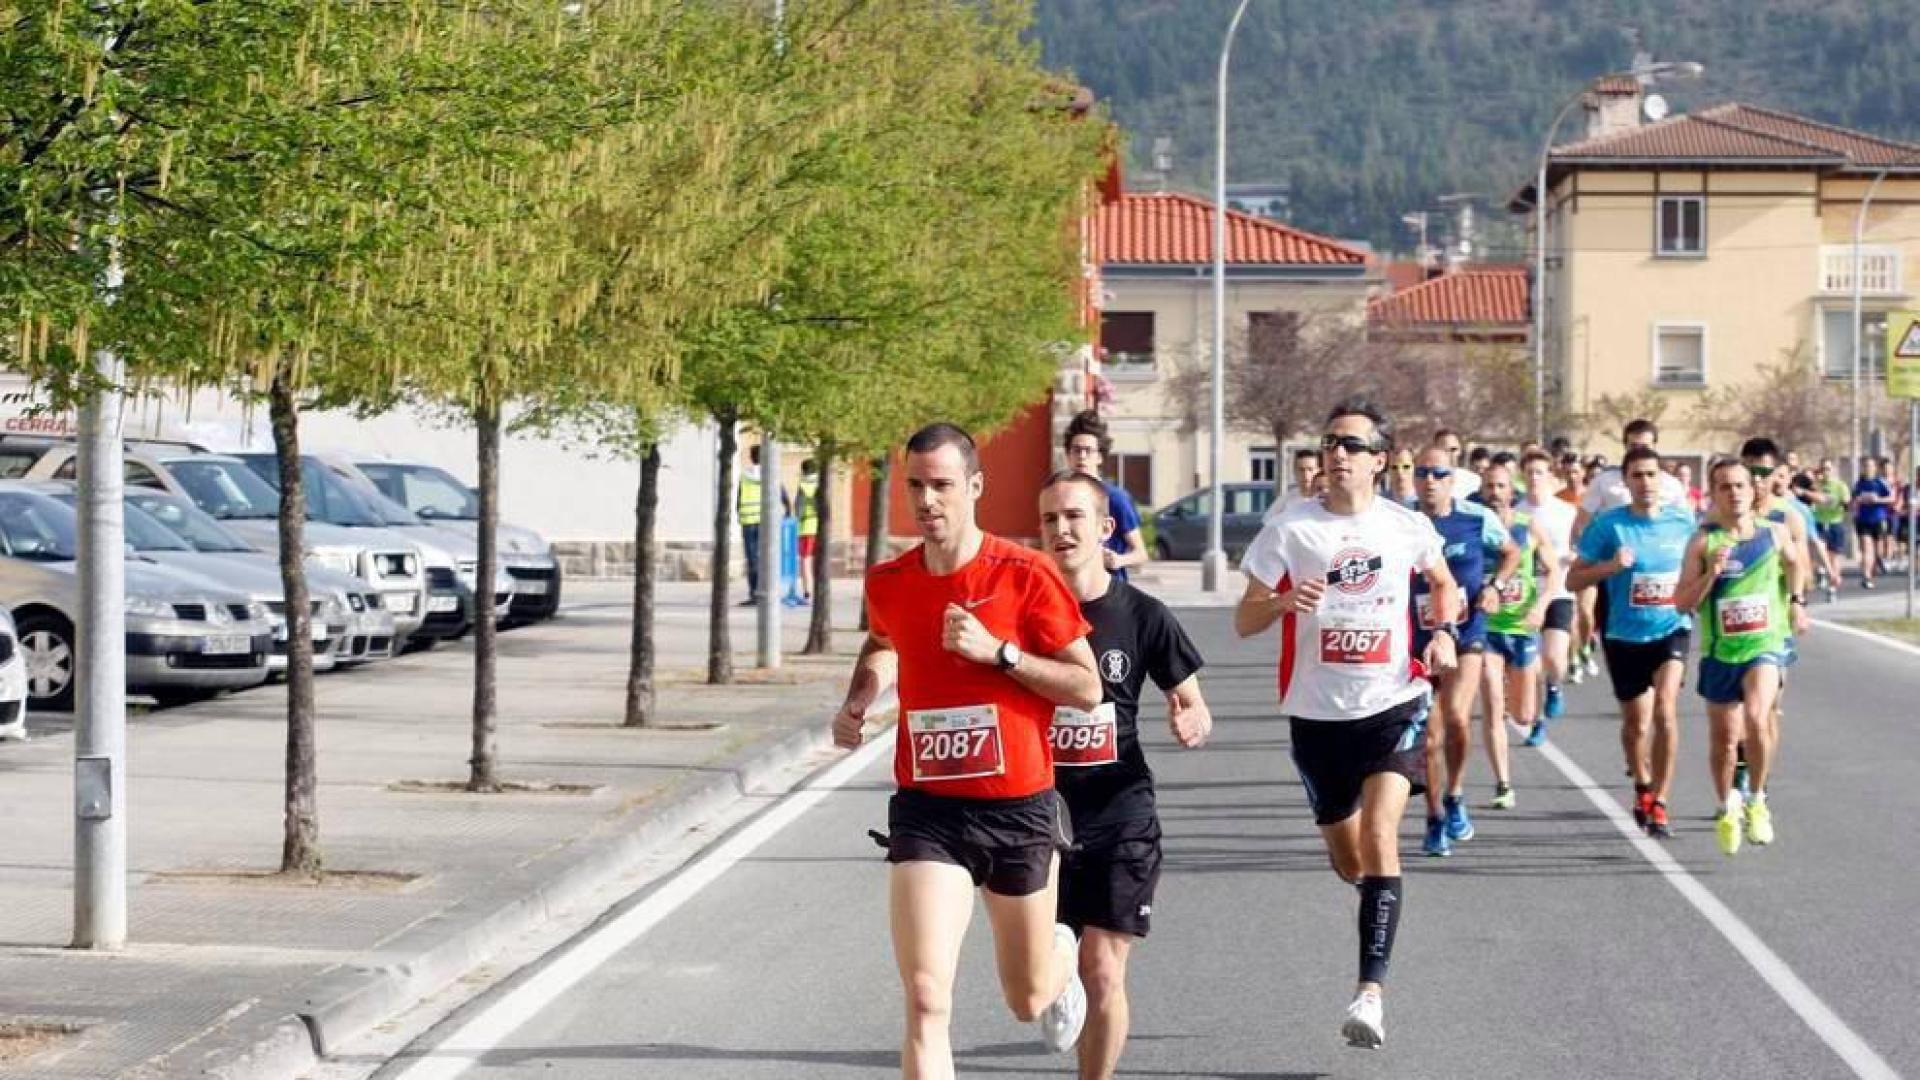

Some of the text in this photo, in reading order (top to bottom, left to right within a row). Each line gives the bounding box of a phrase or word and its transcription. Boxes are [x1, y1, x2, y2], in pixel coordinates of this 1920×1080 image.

[1325, 631, 1387, 653] 2067
[920, 729, 990, 761] 2087
[1047, 725, 1108, 750] 2095
